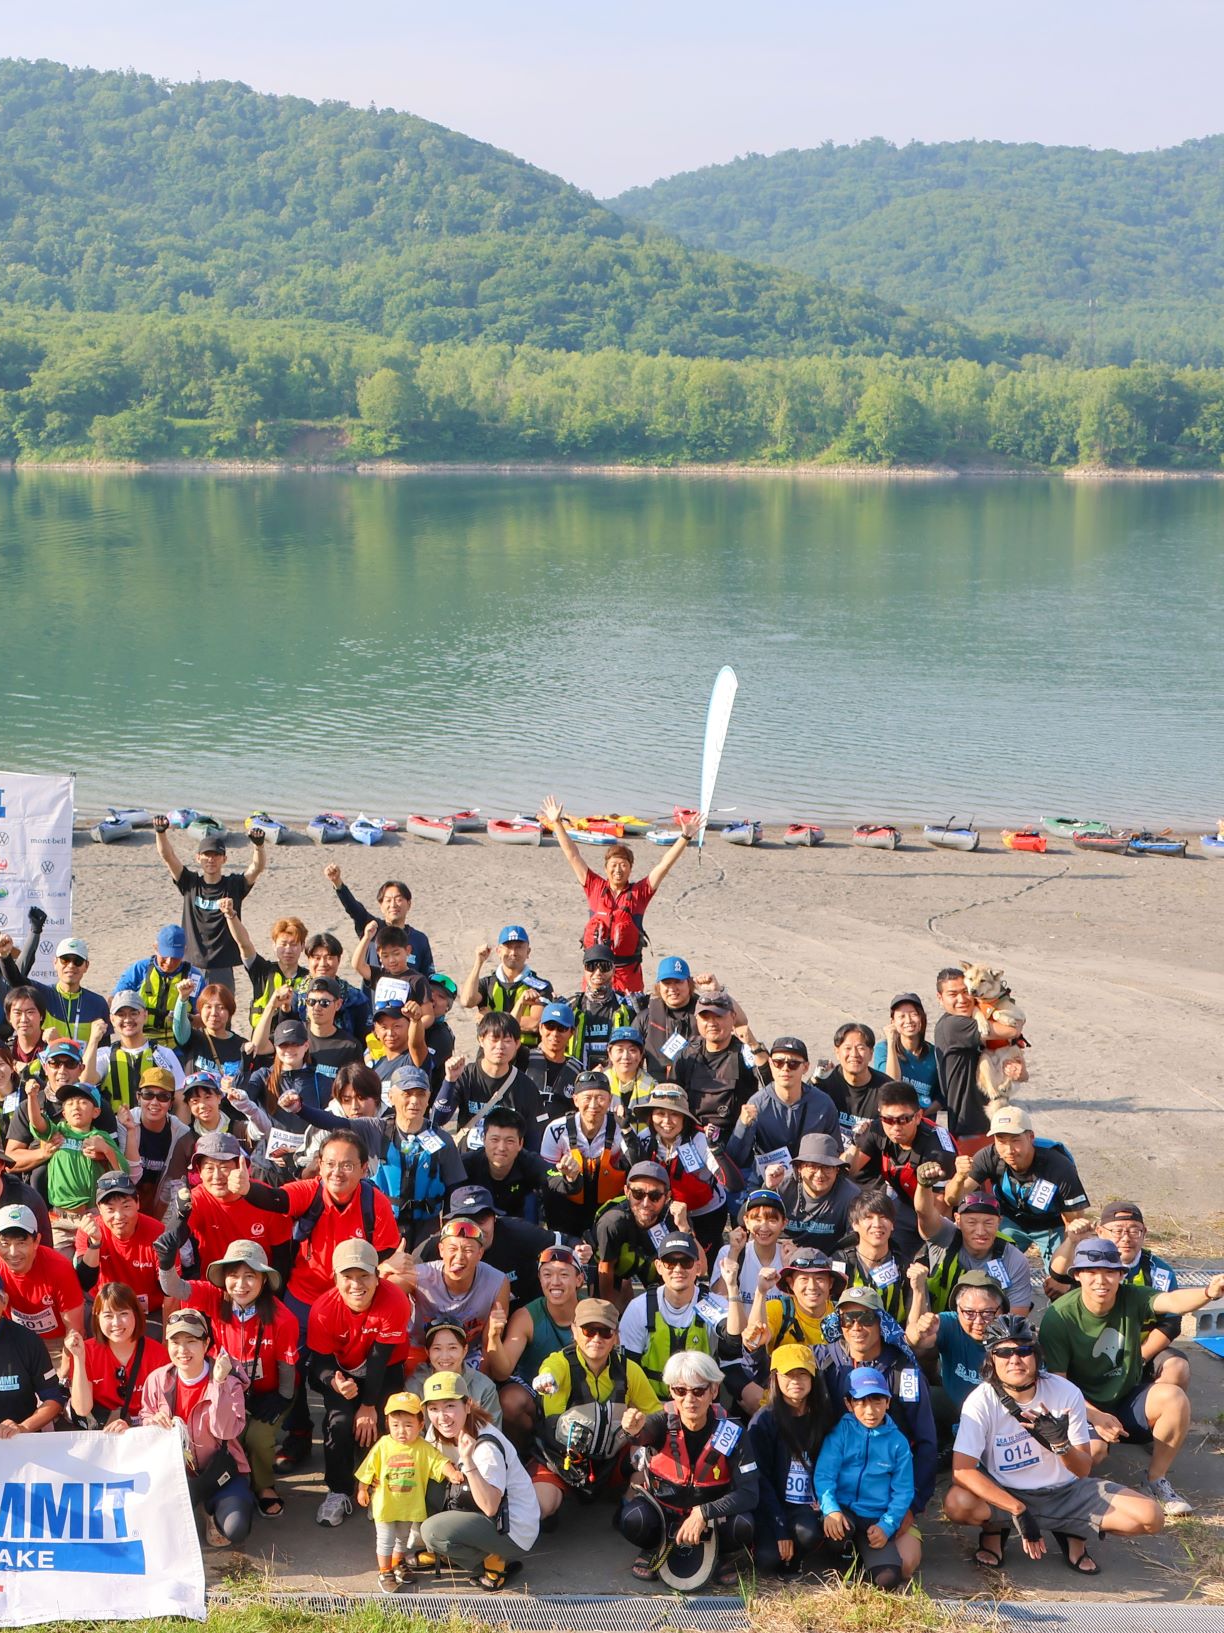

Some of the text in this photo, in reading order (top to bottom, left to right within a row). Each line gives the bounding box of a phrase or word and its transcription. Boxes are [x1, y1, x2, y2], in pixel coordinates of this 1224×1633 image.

[1036, 1186, 1050, 1204] 019
[720, 1426, 736, 1448] 002
[1004, 1441, 1032, 1462] 014
